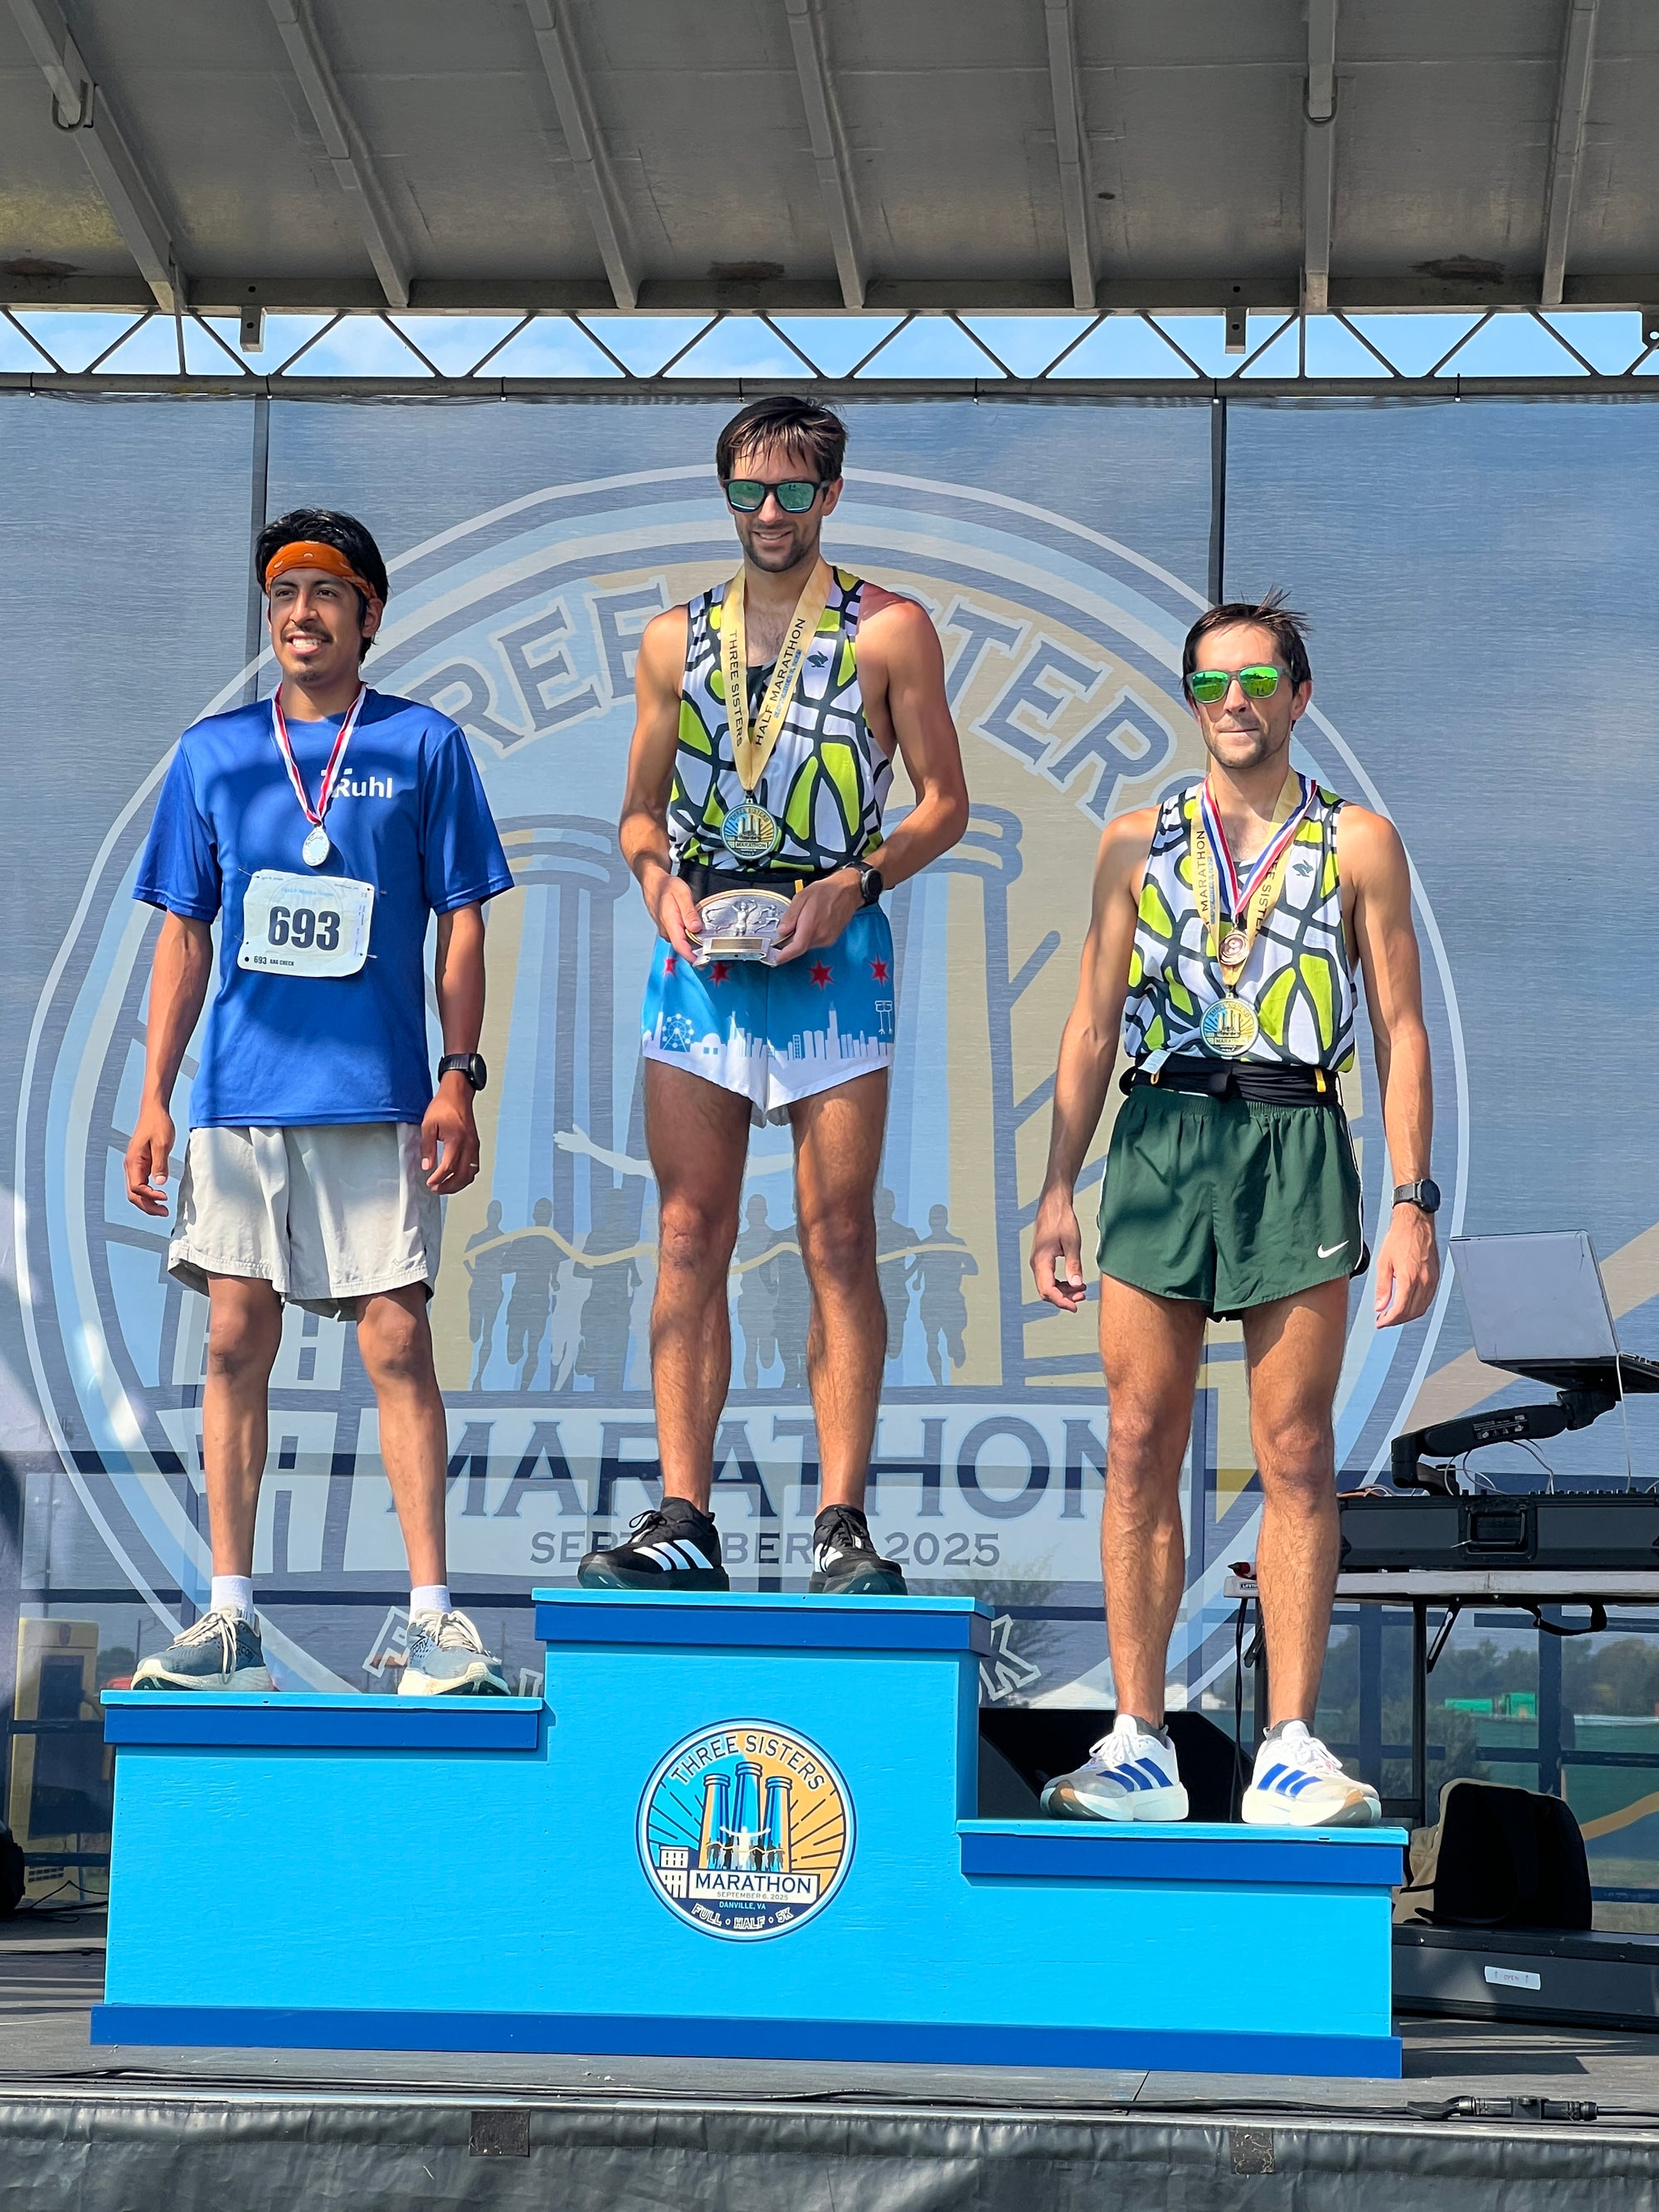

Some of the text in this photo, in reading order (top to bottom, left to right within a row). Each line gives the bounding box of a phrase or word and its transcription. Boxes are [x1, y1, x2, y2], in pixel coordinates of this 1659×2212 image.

[401, 579, 669, 755] REE
[755, 618, 806, 746] HALF MARATHON
[729, 630, 744, 746] THREE SISTERS
[332, 776, 393, 799] Ruhl
[1196, 830, 1210, 912] MARATHON
[268, 906, 341, 951] 693
[1254, 884, 1272, 937] SISTE
[254, 955, 267, 965] 693
[530, 1531, 1000, 1567] SEPBER 2025
[670, 1734, 825, 1790] THREE SISTERS
[695, 1873, 811, 1894] MARATHON
[717, 1891, 761, 1899] SEPTEMBER
[691, 1903, 794, 1929] FULL HALF 5K
[718, 1901, 756, 1910] DANVILLE,
